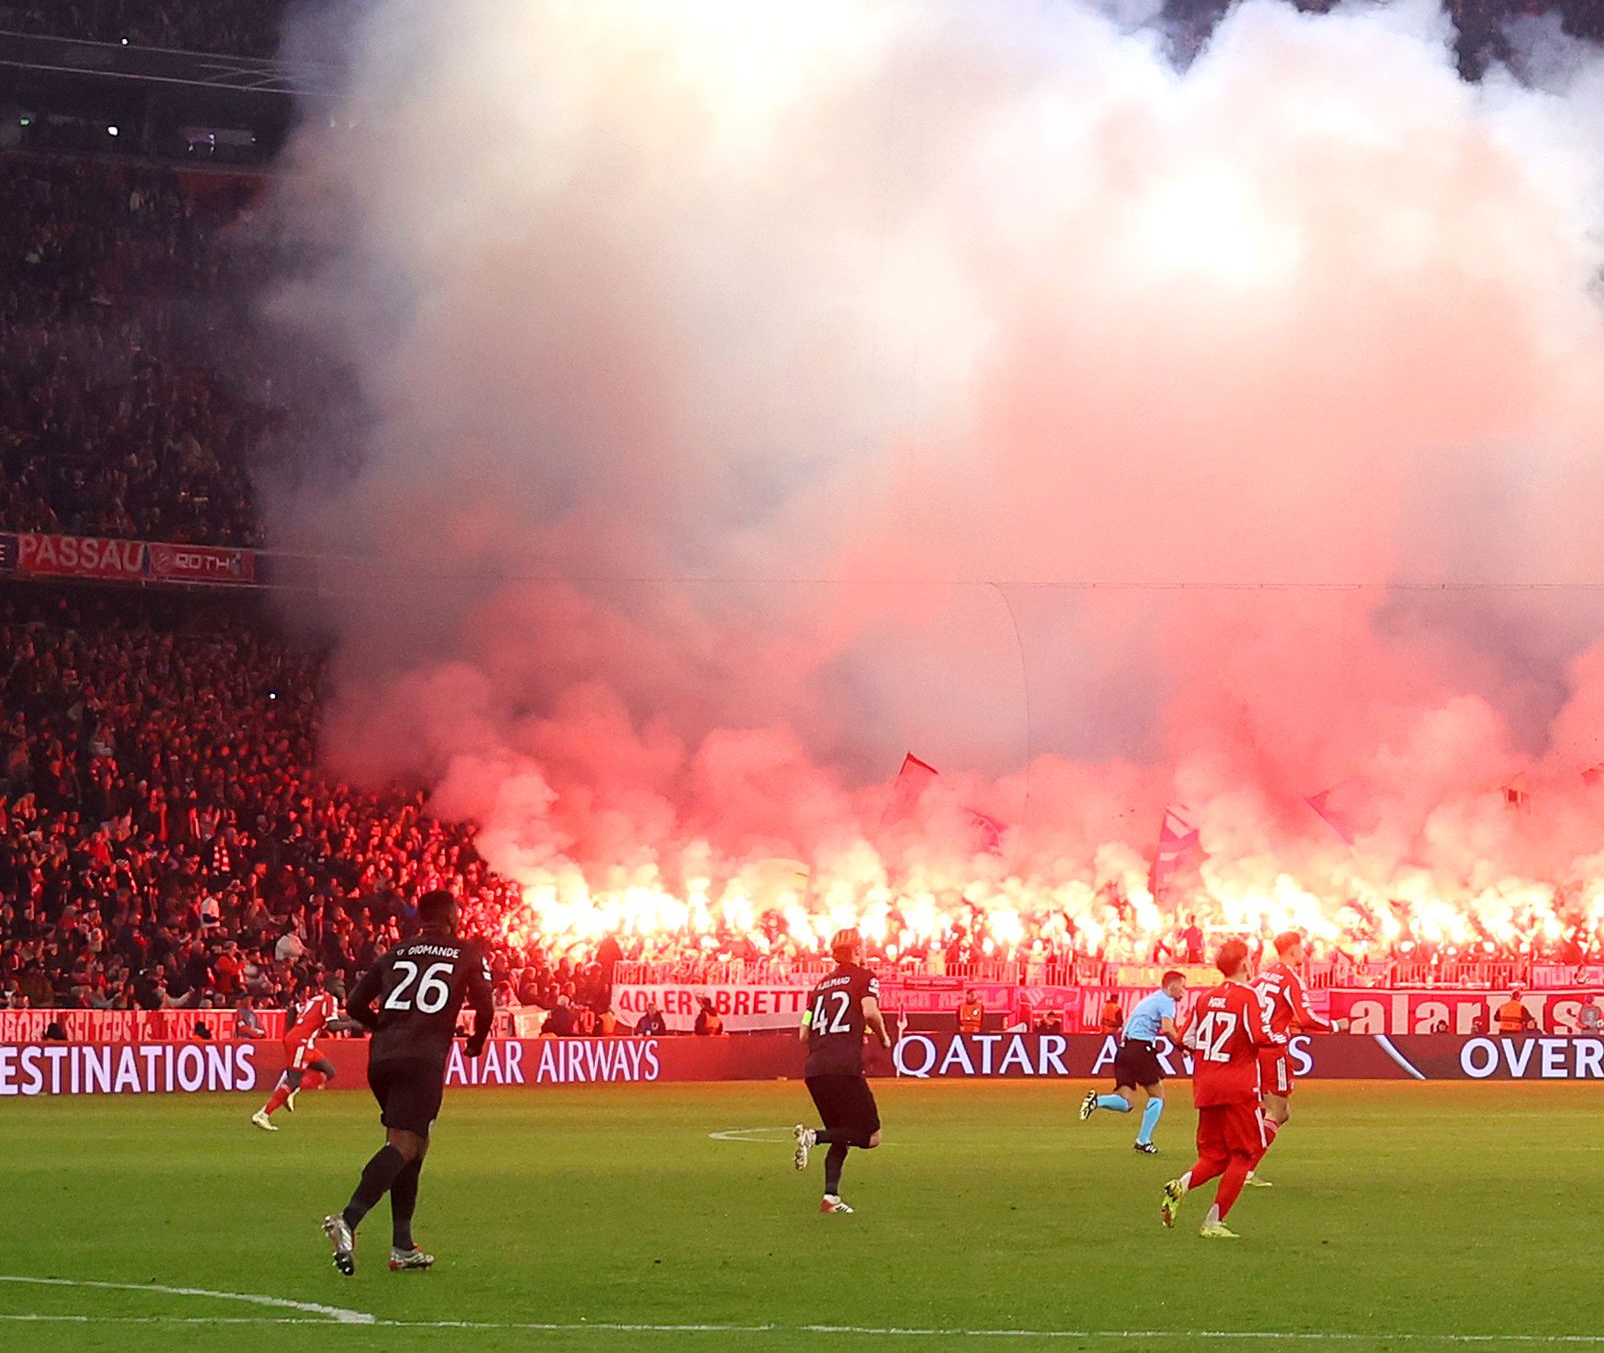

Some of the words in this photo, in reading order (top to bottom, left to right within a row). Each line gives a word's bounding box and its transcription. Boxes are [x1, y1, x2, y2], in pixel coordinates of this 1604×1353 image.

[17, 533, 146, 573] PASSAU
[384, 960, 454, 1014] 26
[618, 990, 692, 1016] ADLER
[811, 990, 851, 1037] 42
[892, 1035, 1069, 1078] QATAR
[1196, 1011, 1237, 1063] 42
[536, 1039, 660, 1084] AIRWAYS
